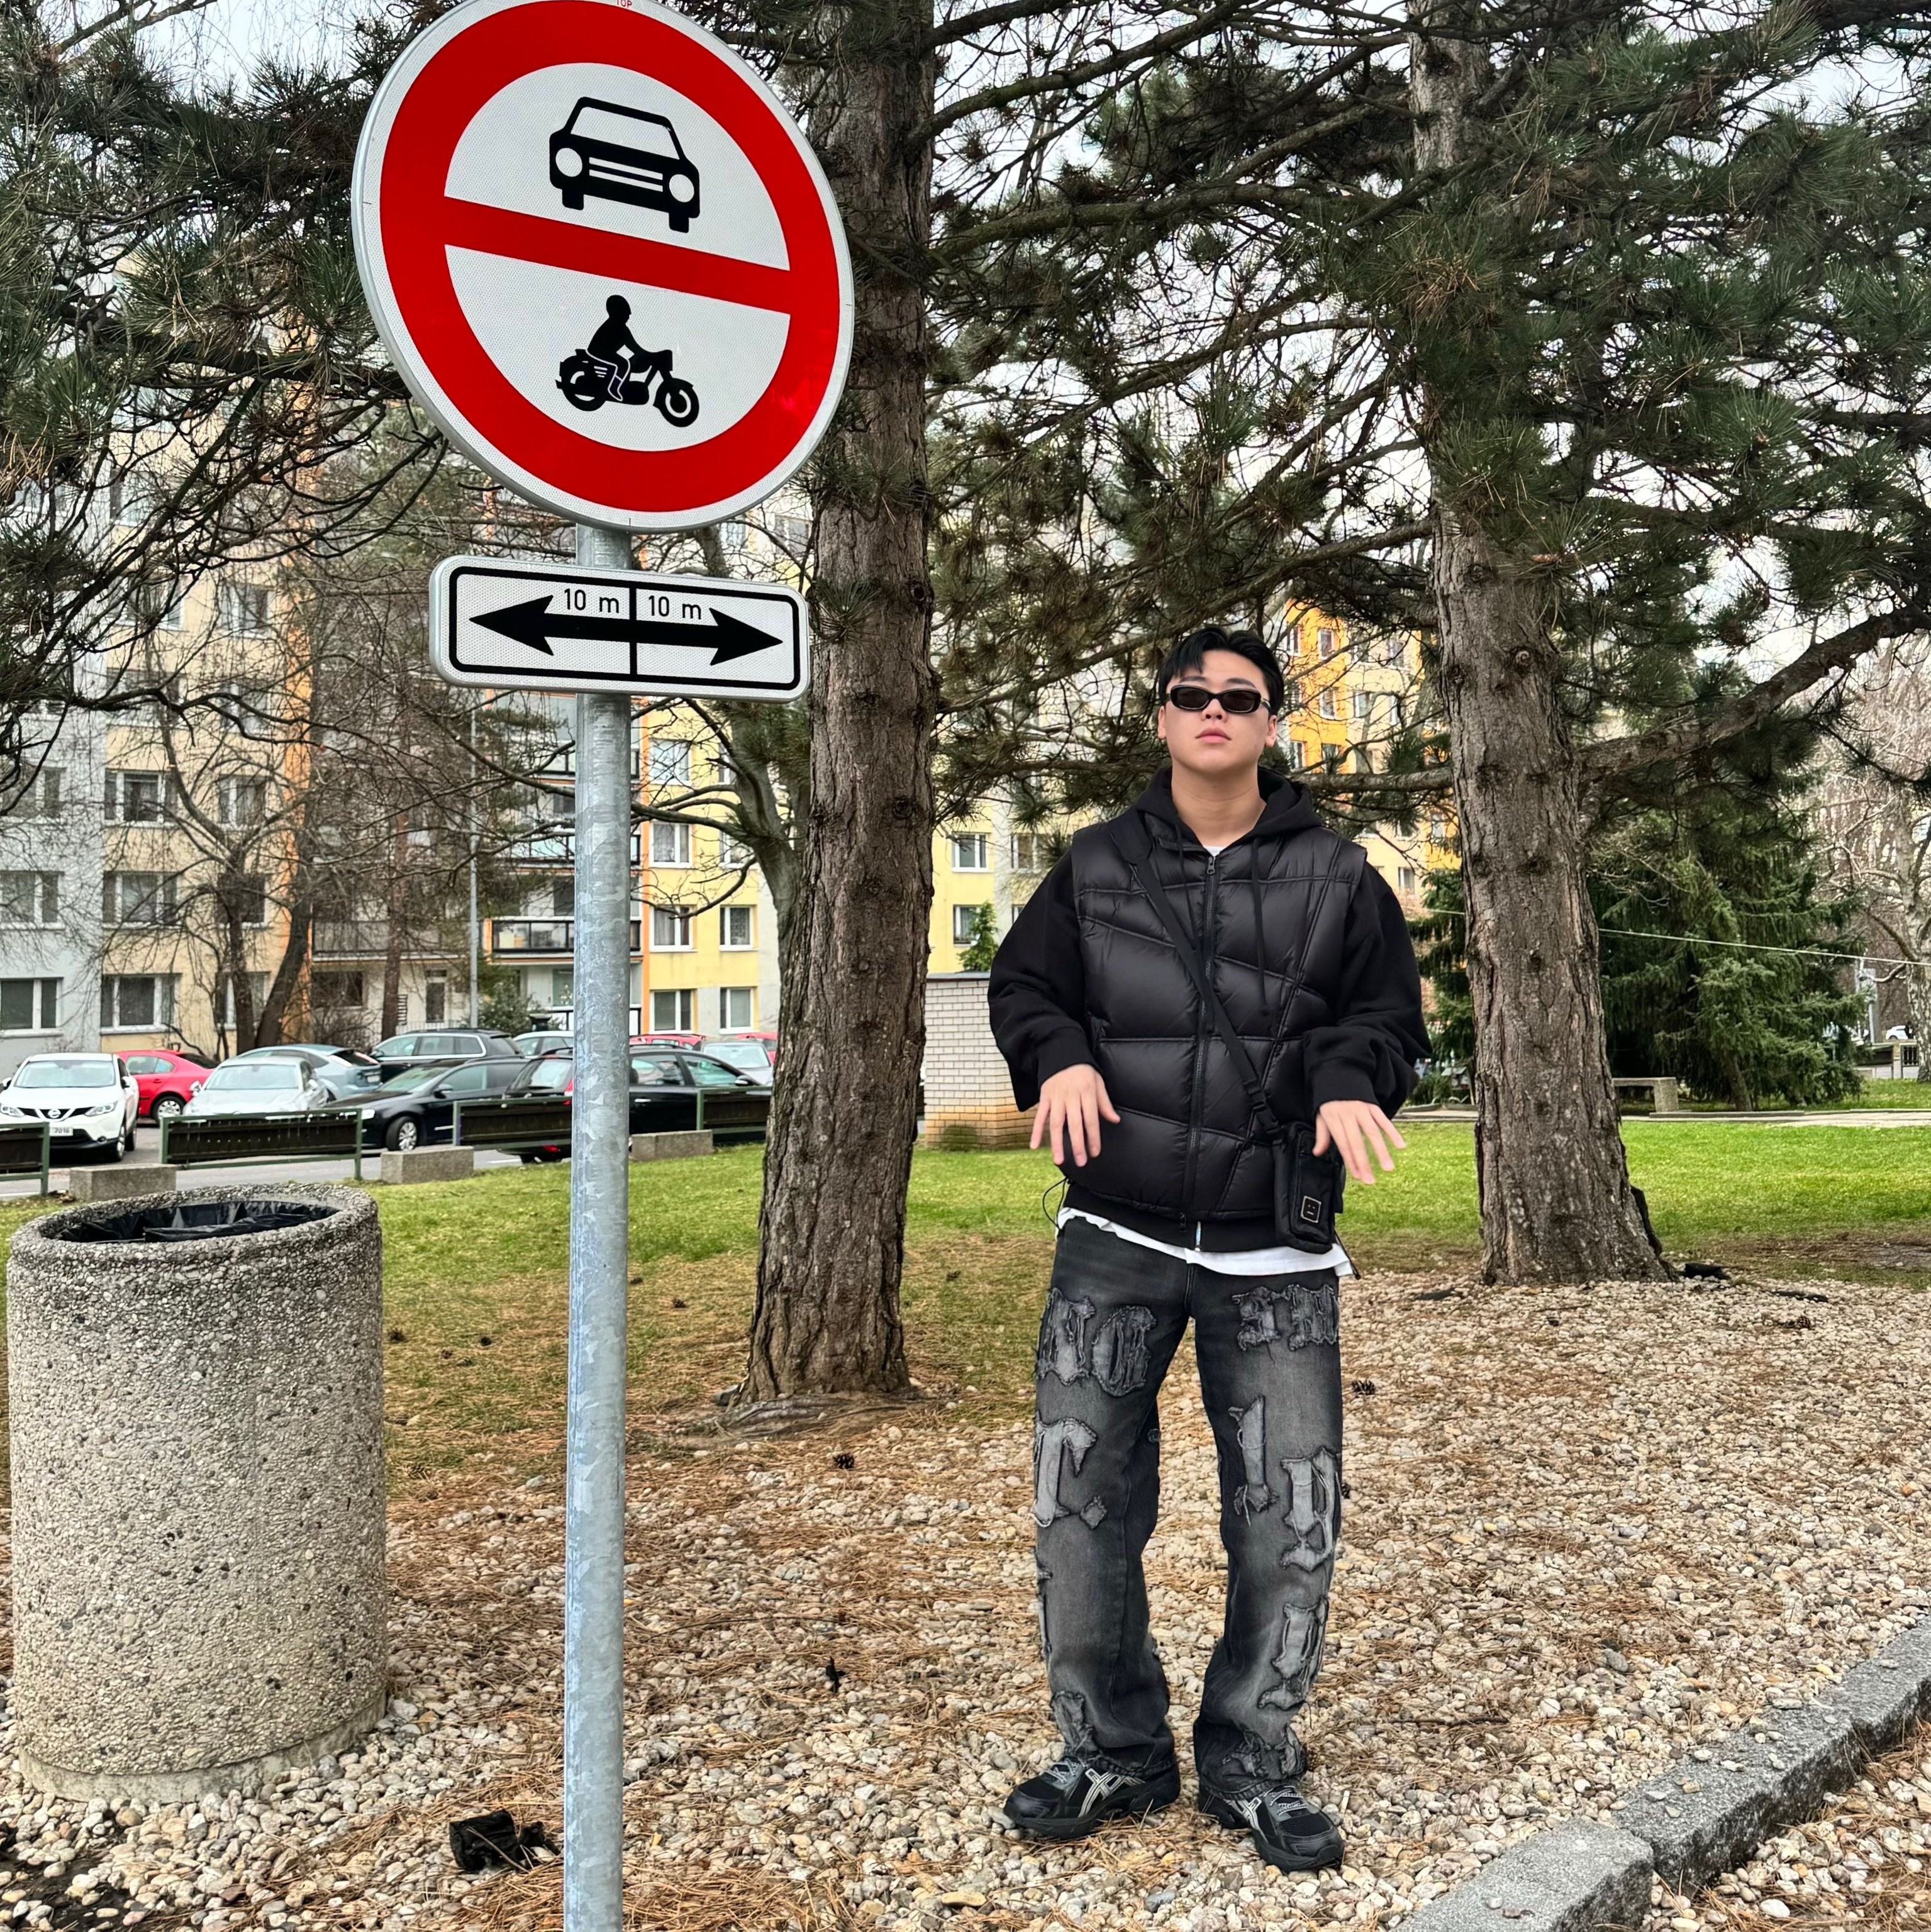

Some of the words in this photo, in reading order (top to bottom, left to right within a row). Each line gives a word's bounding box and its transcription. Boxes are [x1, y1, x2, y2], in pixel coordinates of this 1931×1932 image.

[564, 588, 586, 611] 10
[599, 597, 619, 613] m
[648, 595, 669, 617] 10
[682, 603, 701, 619] m
